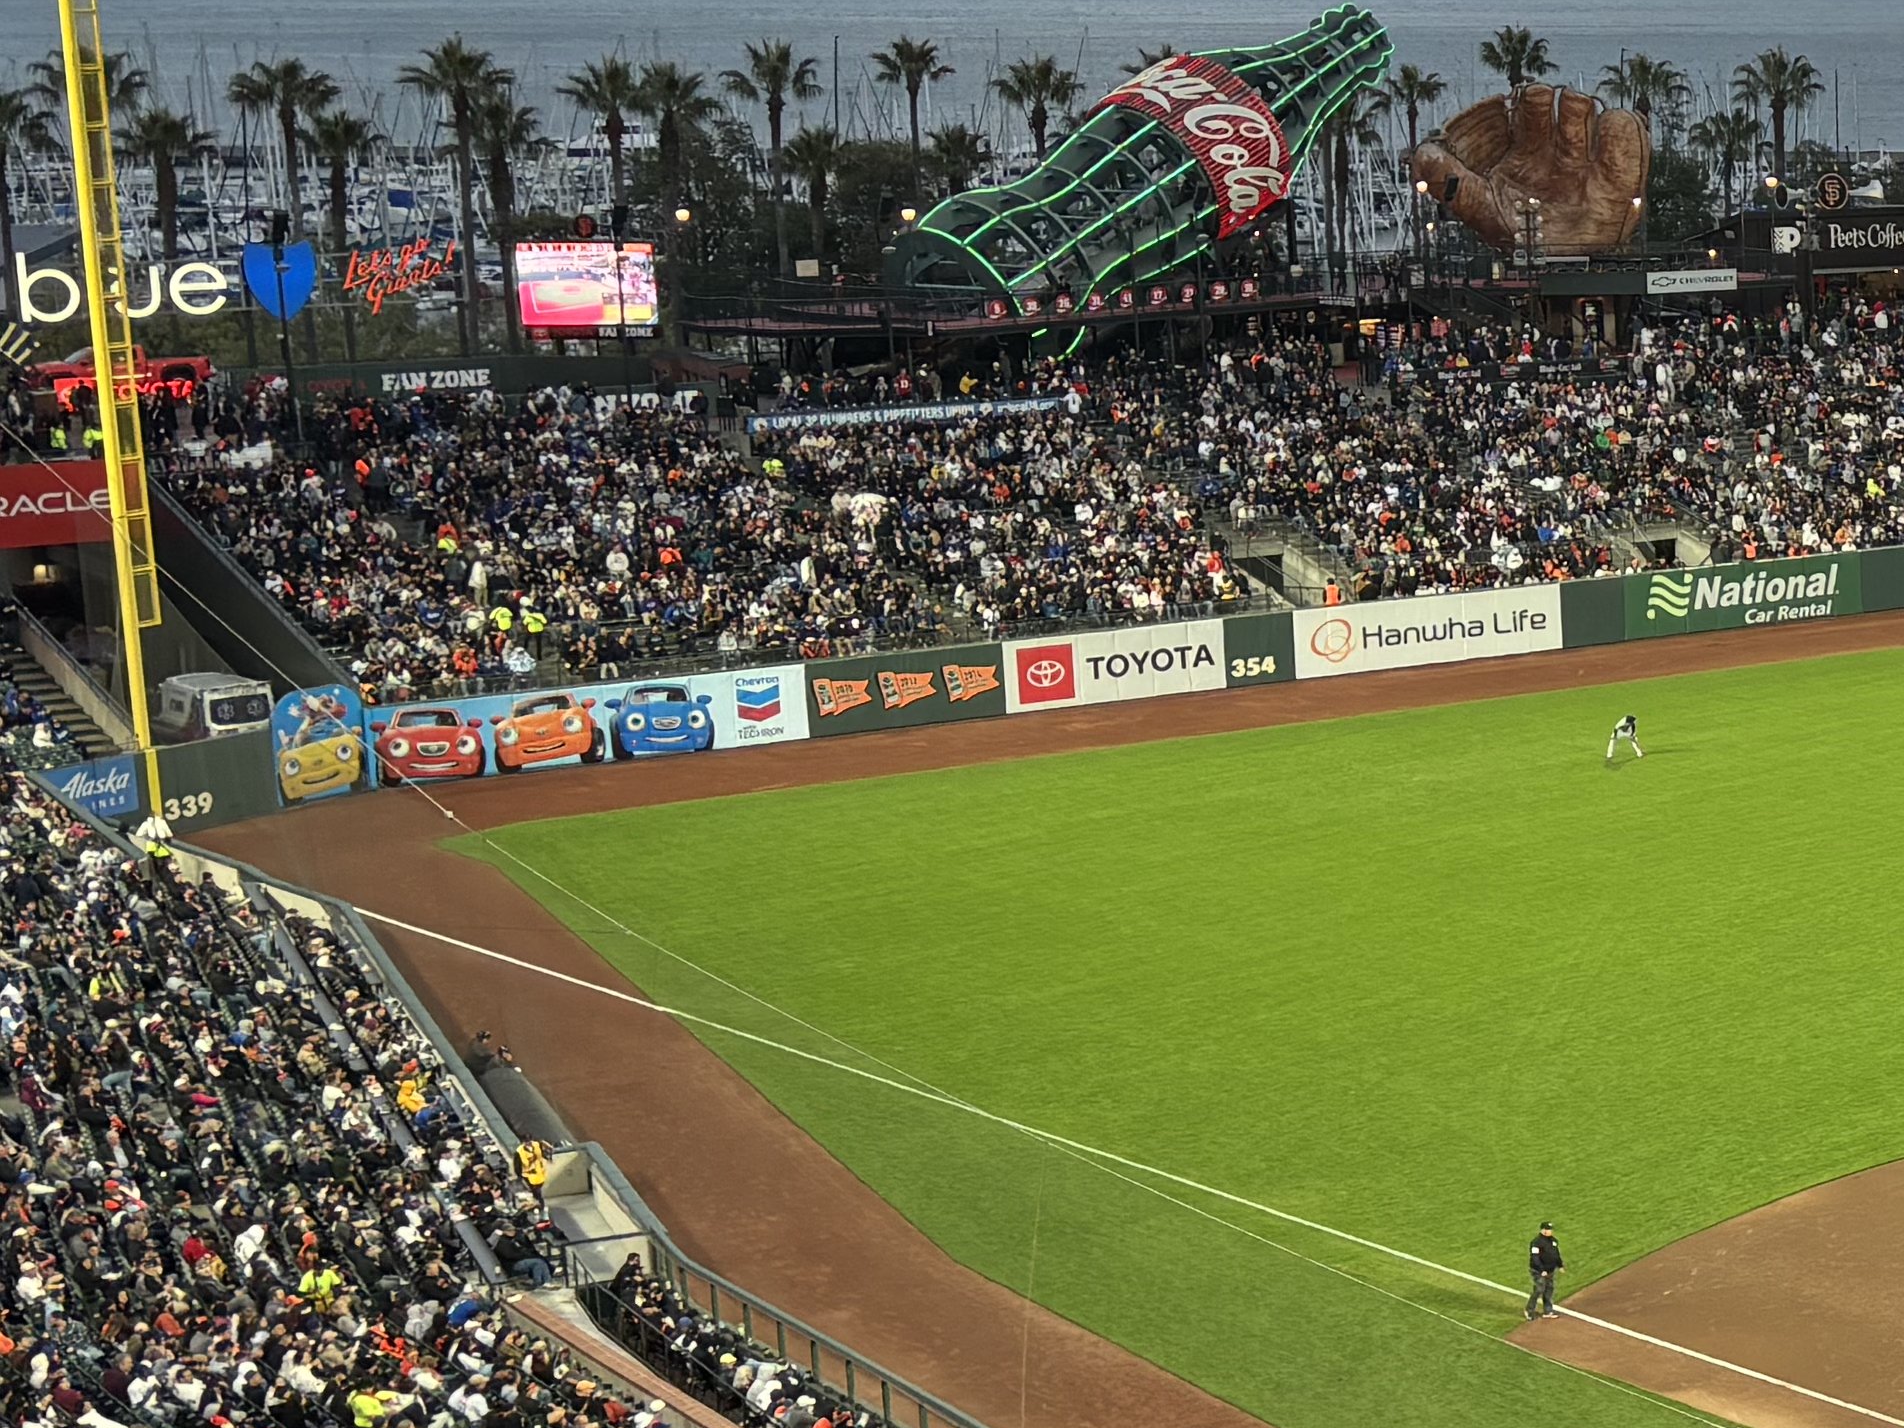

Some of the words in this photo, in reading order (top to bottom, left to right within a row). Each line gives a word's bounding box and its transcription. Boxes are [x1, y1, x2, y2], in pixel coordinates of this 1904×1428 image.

[1829, 222, 1866, 249] Peet's
[15, 252, 228, 322] bue
[1679, 273, 1735, 286] CHEVROLET
[381, 372, 428, 392] FAN
[431, 369, 491, 389] ZONE
[1694, 564, 1838, 610] National
[1494, 608, 1547, 634] Life
[1744, 607, 1775, 625] Car
[1777, 600, 1833, 622] Rental
[1362, 616, 1484, 649] Hanwha
[1085, 644, 1216, 680] TOYOTA
[1231, 655, 1276, 677] 354
[735, 675, 780, 688] Chevron
[737, 726, 785, 740] TECHRON
[61, 767, 131, 801] Alaska
[164, 791, 214, 821] 339
